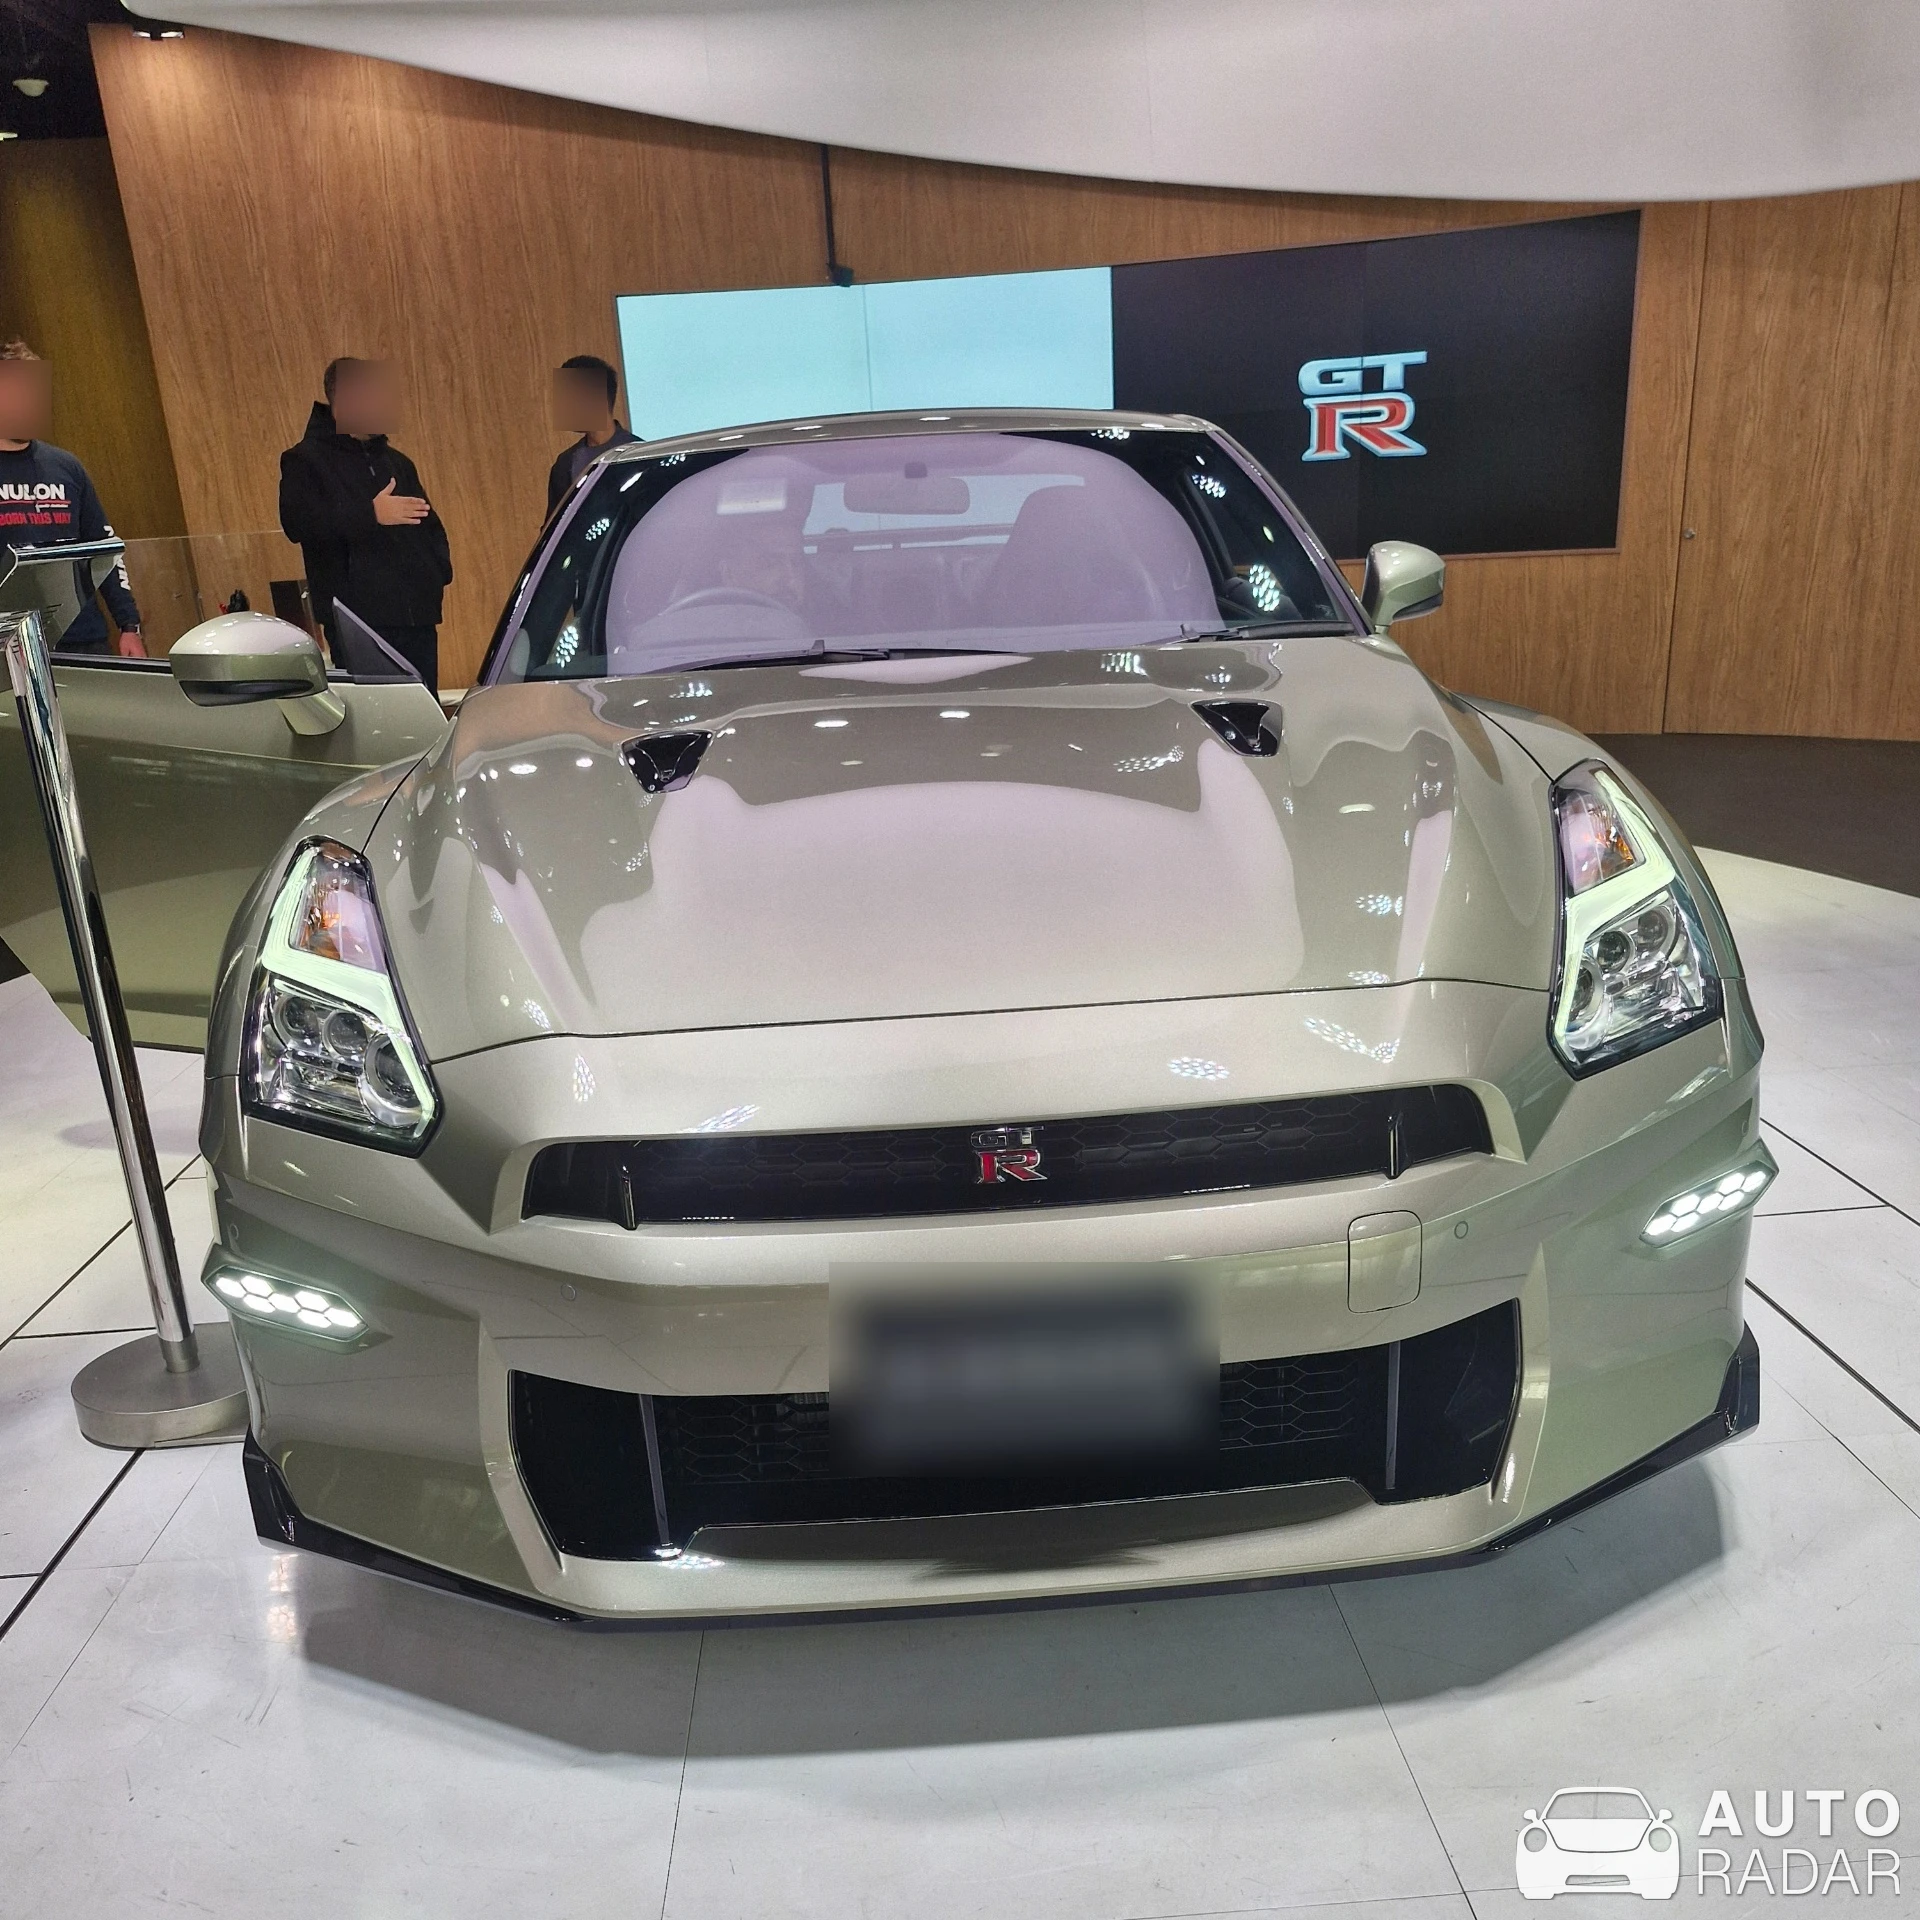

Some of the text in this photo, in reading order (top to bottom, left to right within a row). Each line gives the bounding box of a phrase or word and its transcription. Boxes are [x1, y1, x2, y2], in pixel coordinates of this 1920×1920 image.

[1298, 351, 1427, 395] GT
[1302, 392, 1427, 461] R
[0, 484, 65, 500] NULON
[28, 512, 52, 524] THIS
[53, 512, 71, 524] WAY
[971, 1126, 1044, 1148] GT
[974, 1148, 1048, 1184] R
